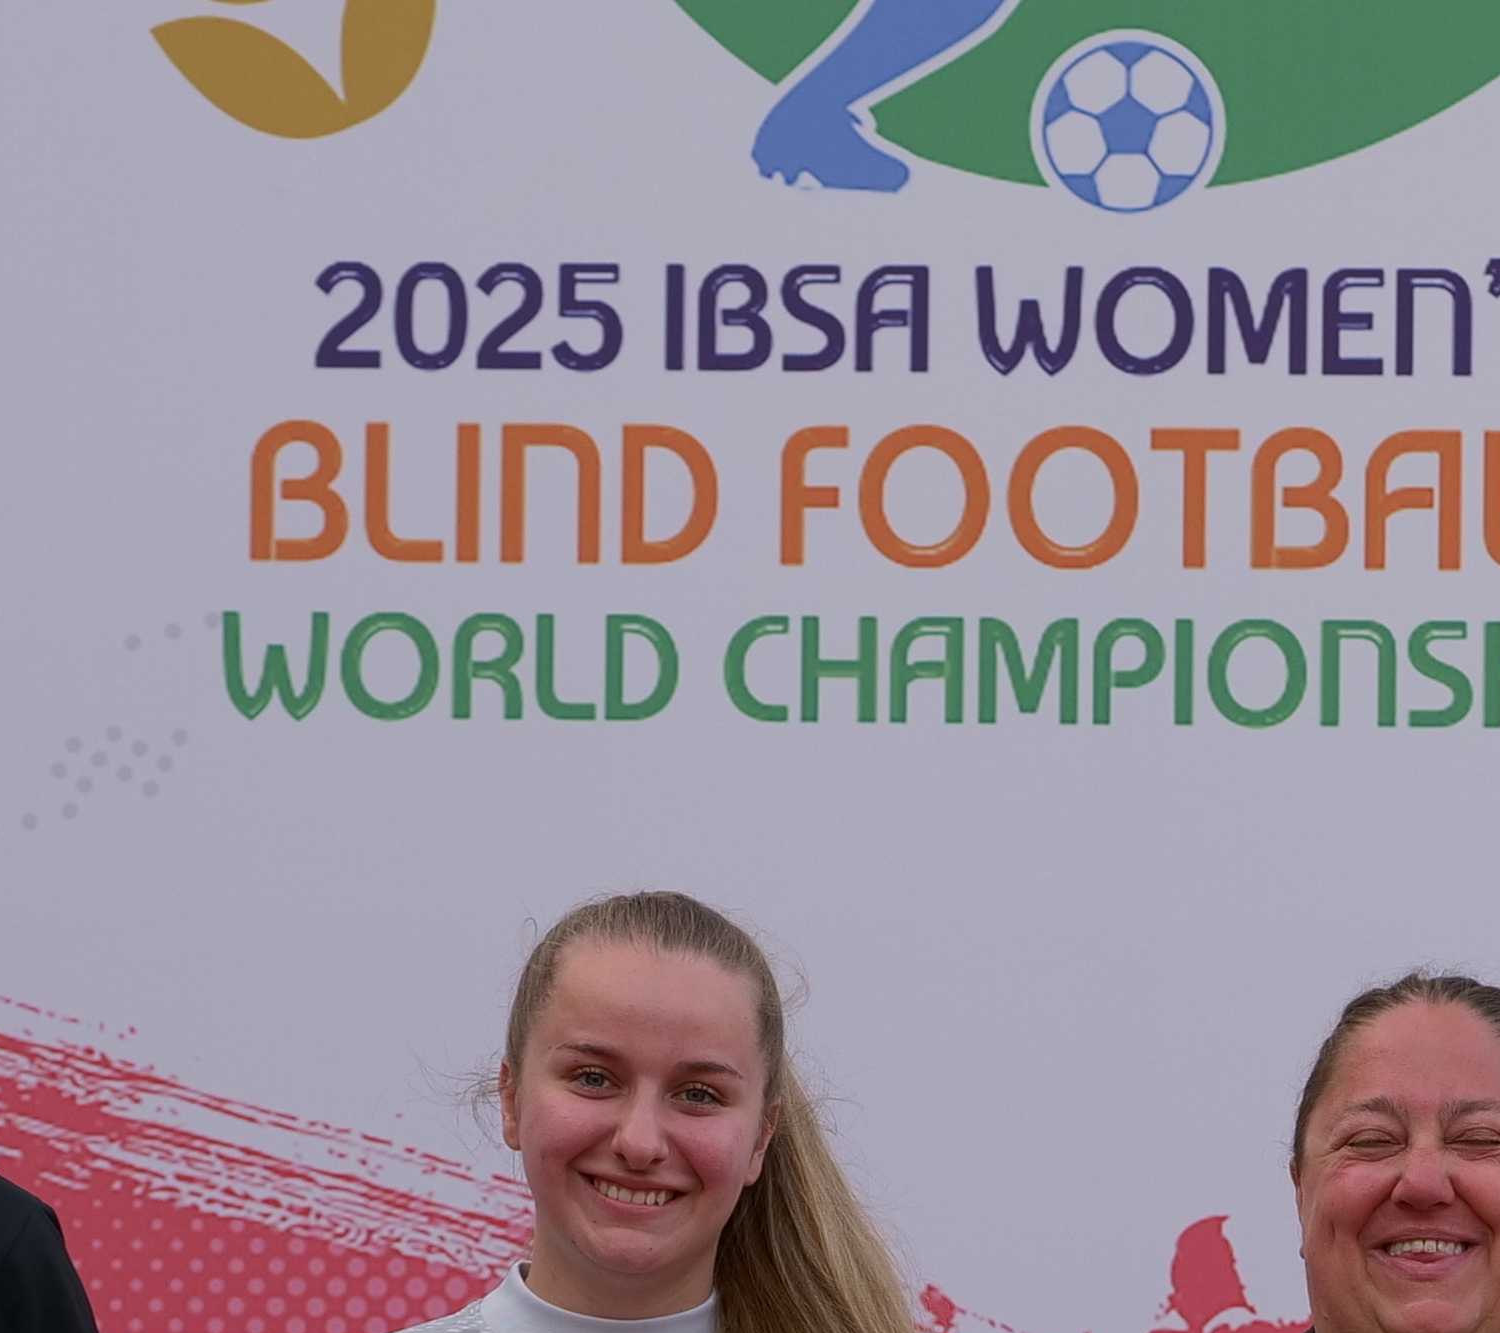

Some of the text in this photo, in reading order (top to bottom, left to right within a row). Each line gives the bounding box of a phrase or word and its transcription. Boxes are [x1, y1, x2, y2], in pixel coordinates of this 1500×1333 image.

[313, 257, 624, 372] 2025
[663, 259, 930, 375] IBSA
[248, 419, 718, 570] BLIND
[220, 610, 680, 724] WORLD
